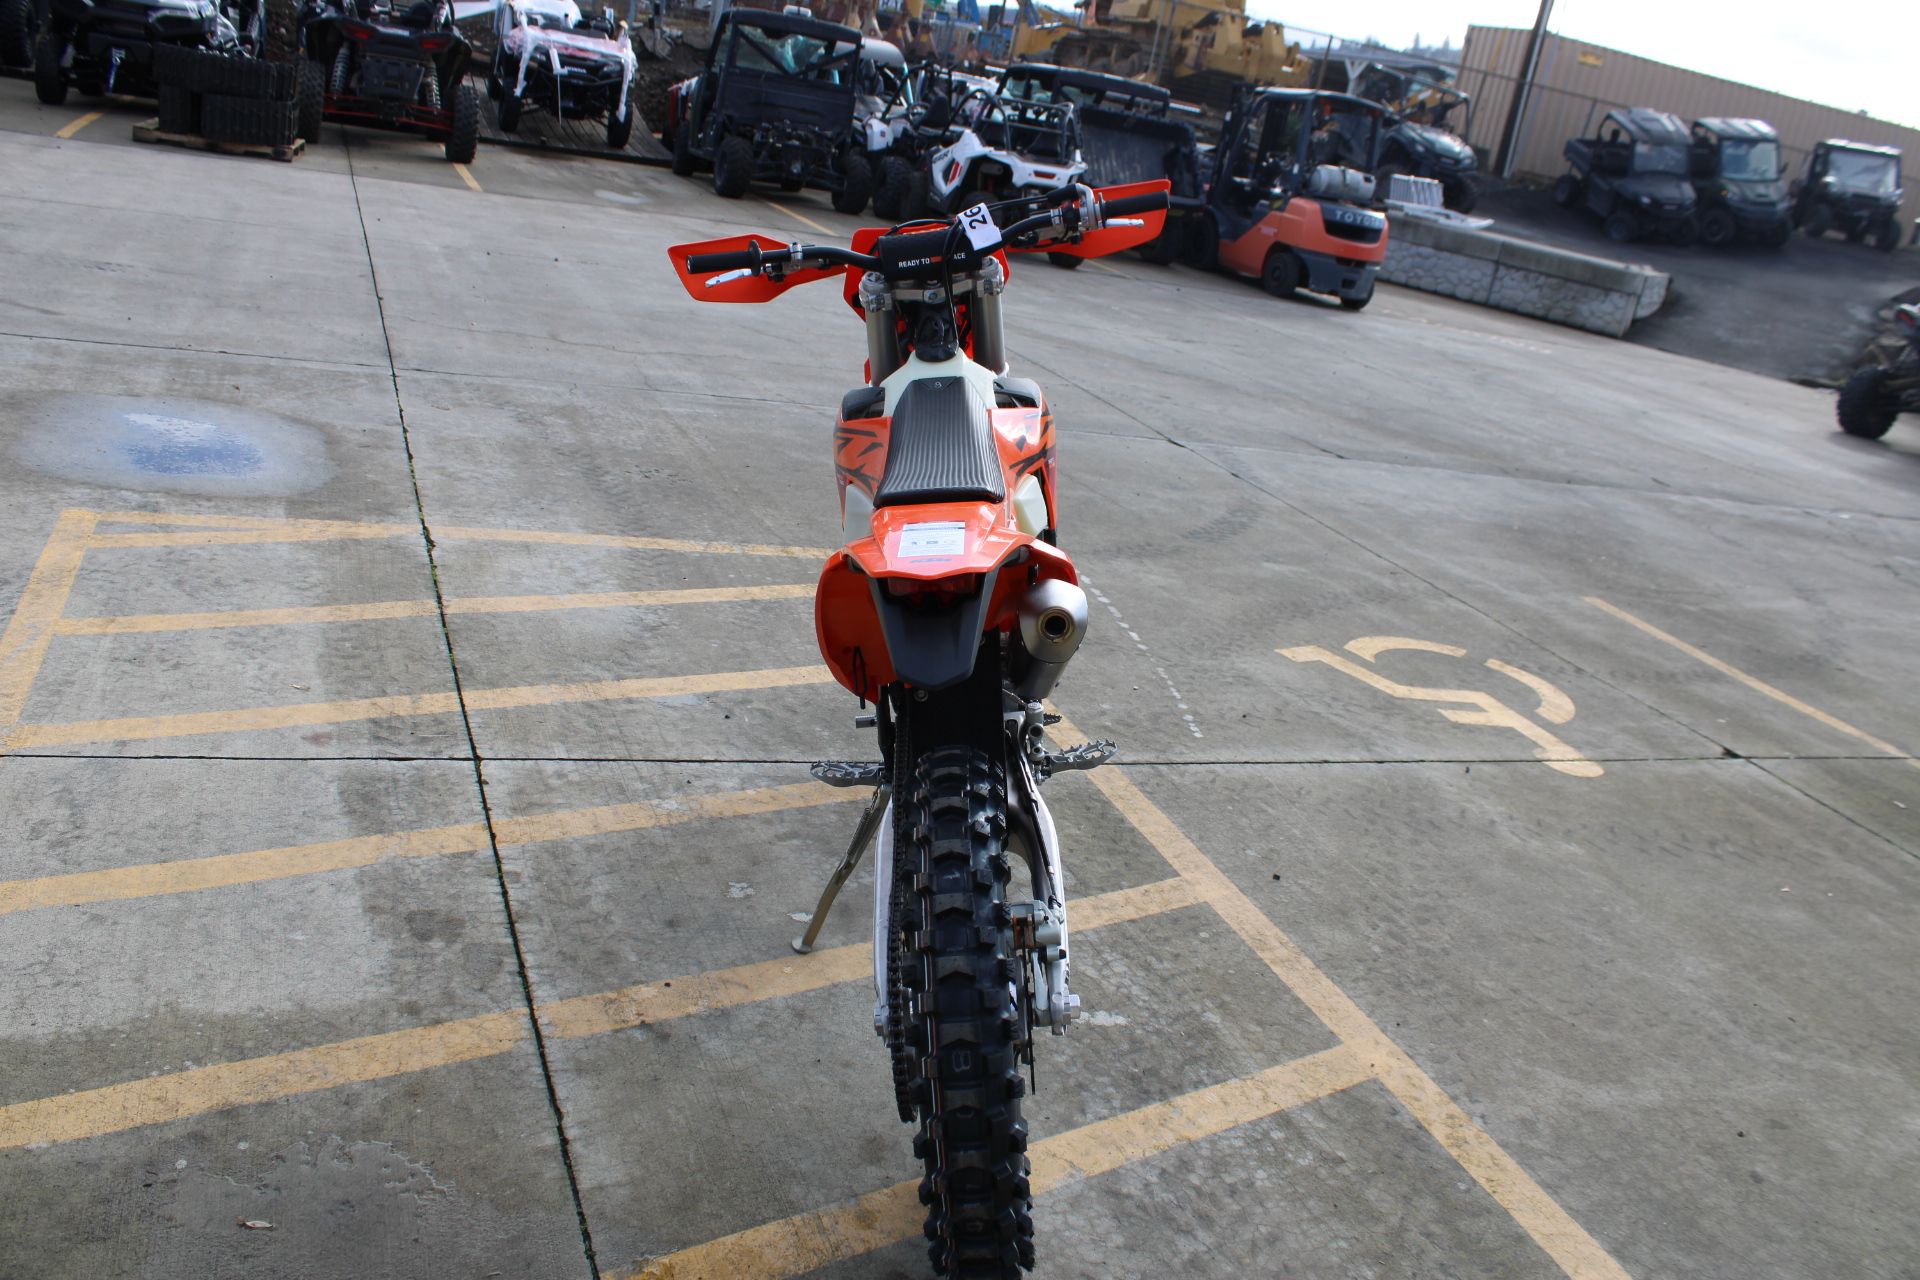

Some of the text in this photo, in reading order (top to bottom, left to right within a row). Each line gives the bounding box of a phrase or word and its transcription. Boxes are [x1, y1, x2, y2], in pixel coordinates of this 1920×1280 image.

[963, 206, 987, 229] 26
[898, 252, 966, 269] READY TO ACE
